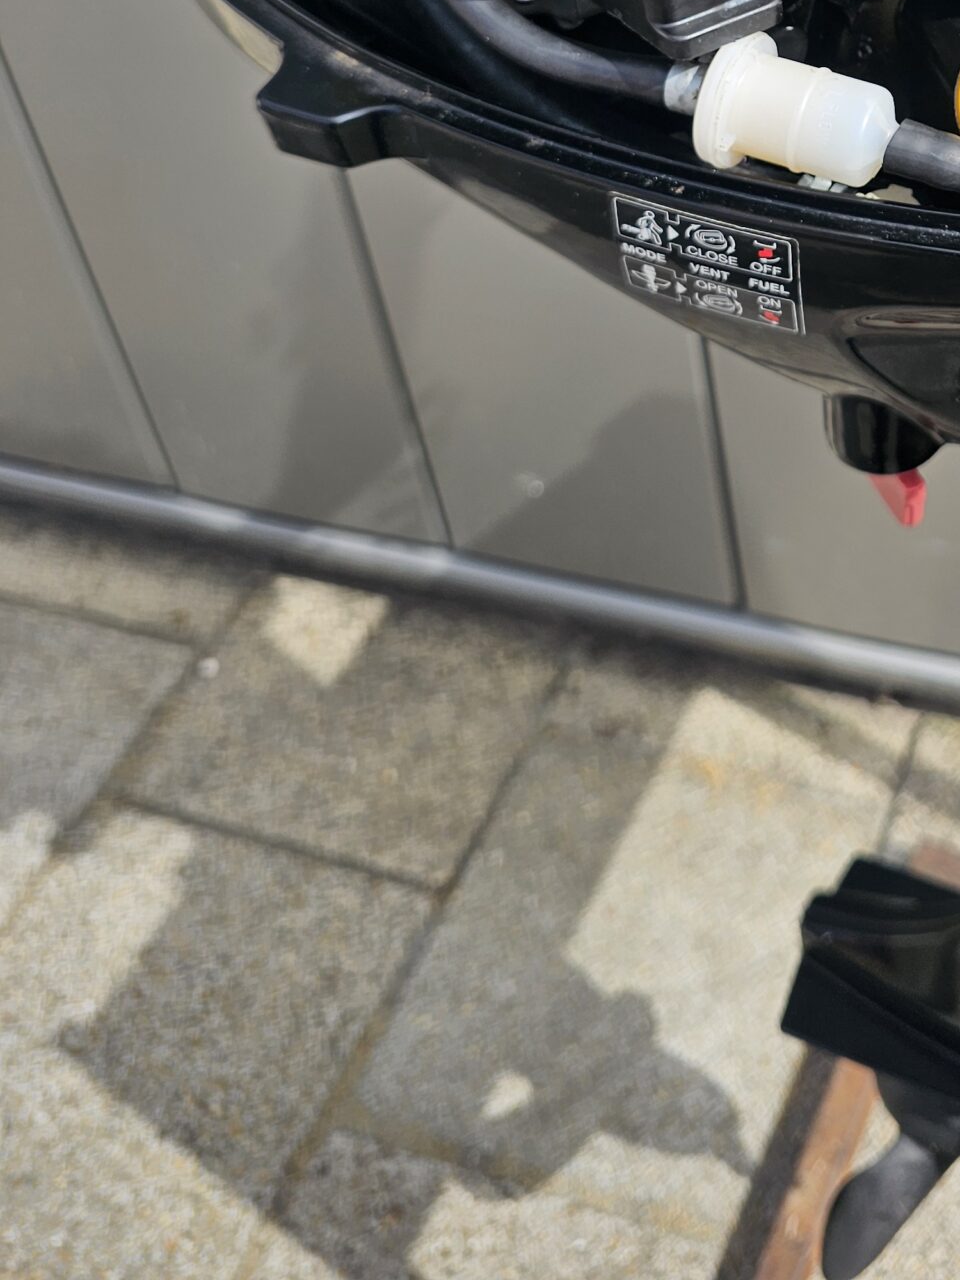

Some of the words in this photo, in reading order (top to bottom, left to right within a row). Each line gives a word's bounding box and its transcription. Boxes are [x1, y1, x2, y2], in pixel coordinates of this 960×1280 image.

[620, 242, 667, 263] MODE
[685, 246, 738, 266] CLOSE
[688, 262, 730, 281] VENT
[749, 261, 782, 276] OFF
[695, 279, 738, 298] OPEN
[748, 277, 790, 296] FUEL
[757, 295, 782, 308] ON
